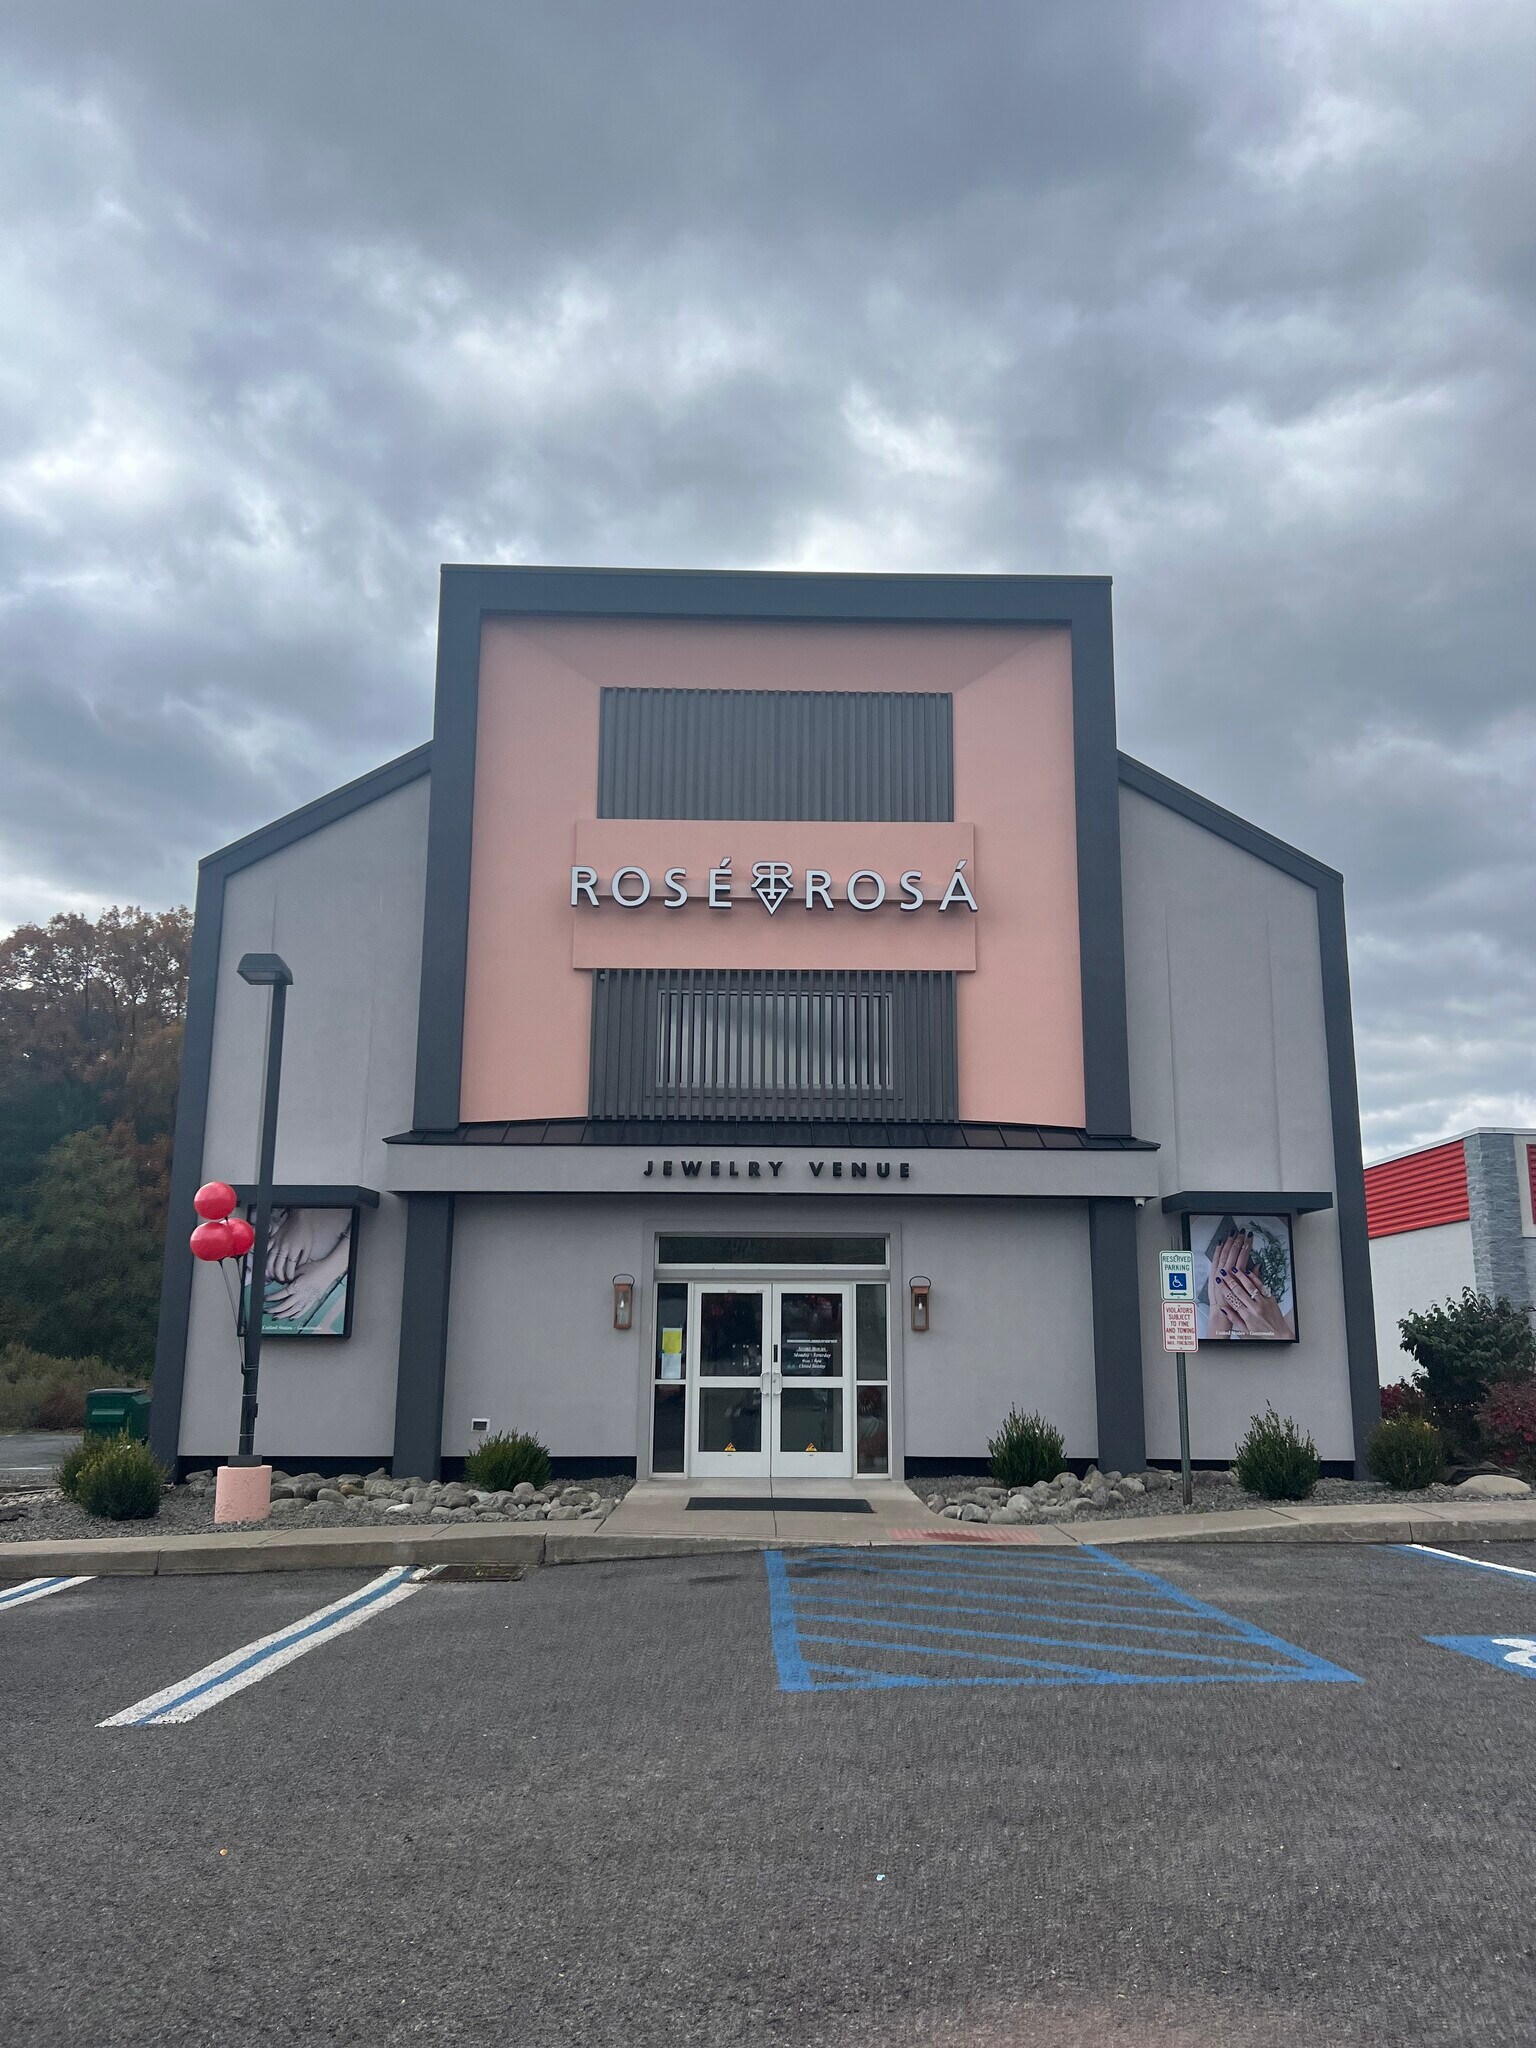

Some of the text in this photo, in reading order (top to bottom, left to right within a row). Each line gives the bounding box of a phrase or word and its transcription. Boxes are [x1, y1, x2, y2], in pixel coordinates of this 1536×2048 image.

[570, 857, 979, 912] ROSÉ ROSÁ
[643, 1160, 910, 1178] JEWELRY VENUE
